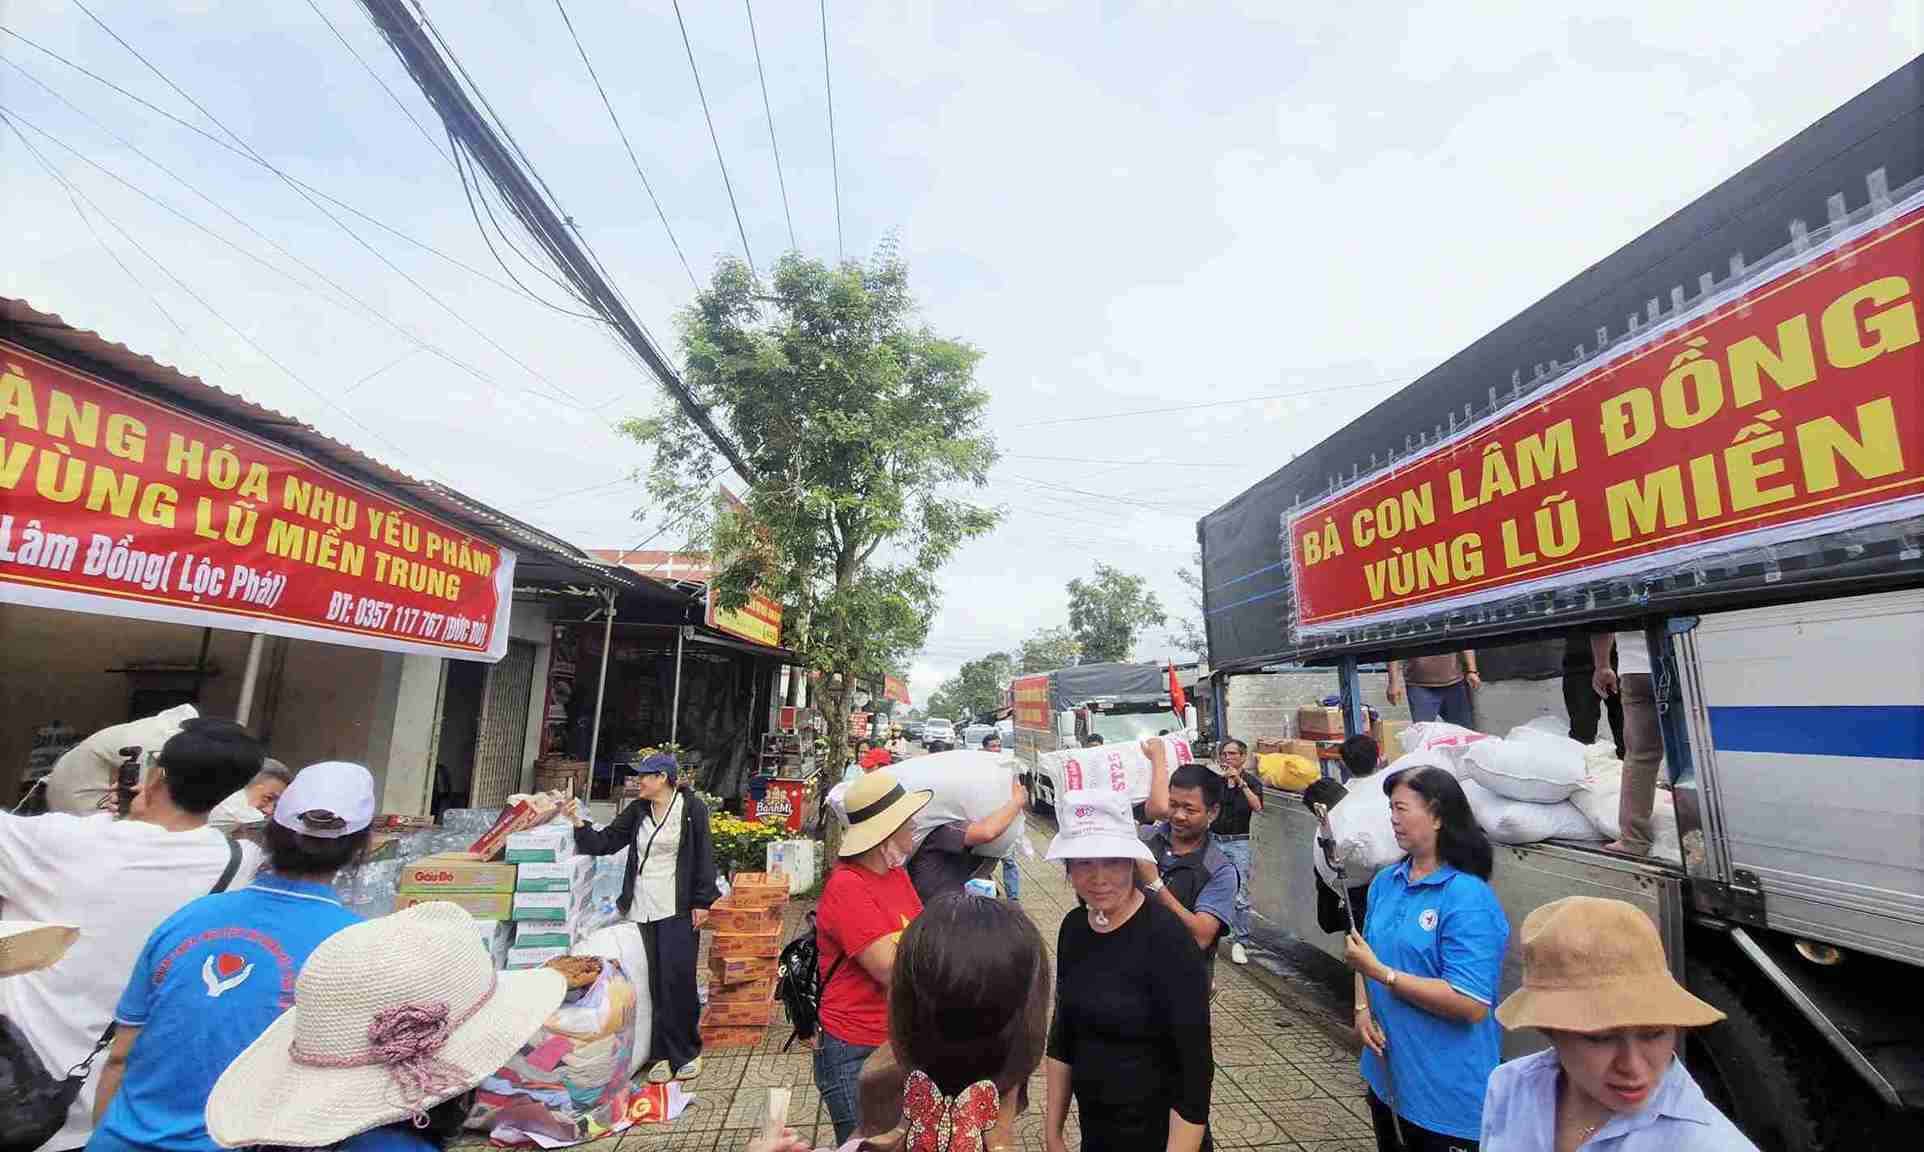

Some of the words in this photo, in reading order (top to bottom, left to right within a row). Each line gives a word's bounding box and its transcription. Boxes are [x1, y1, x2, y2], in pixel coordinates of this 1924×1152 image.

[1302, 516, 1344, 566] BÀ
[1352, 481, 1436, 548] CON
[1448, 419, 1579, 514] LÂM
[1600, 275, 1921, 457] ĐỒNG
[0, 515, 78, 571] Lâm
[166, 432, 269, 503] HÓA
[368, 508, 419, 553] YẾU
[1363, 532, 1486, 601] VÙNG
[1501, 490, 1581, 569] LŨ
[1605, 396, 1905, 543] MIỀN
[195, 497, 258, 546] LŨ
[266, 518, 366, 577] MIỀN
[374, 550, 461, 601] TRUNG
[354, 597, 393, 631] 0357
[393, 605, 420, 634] 117
